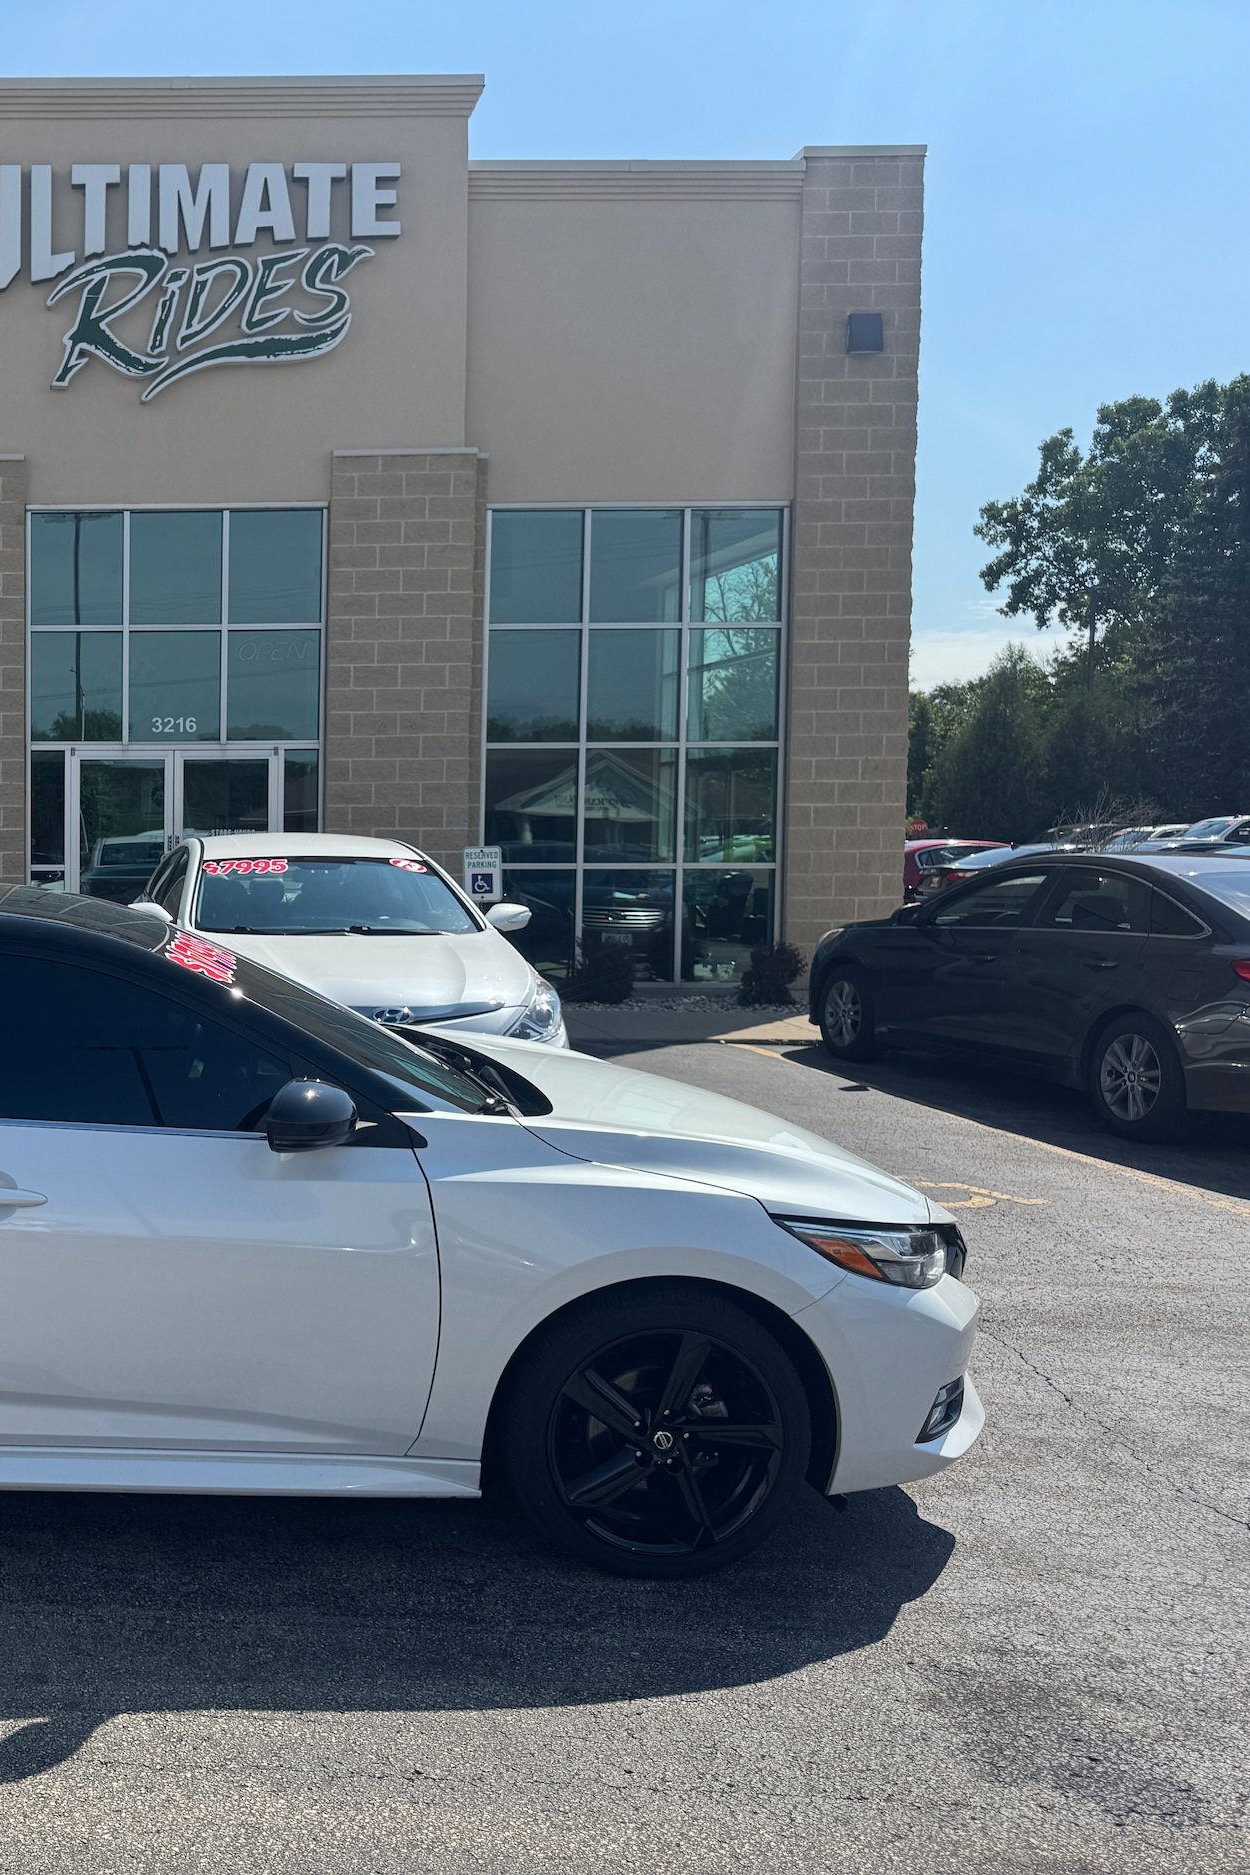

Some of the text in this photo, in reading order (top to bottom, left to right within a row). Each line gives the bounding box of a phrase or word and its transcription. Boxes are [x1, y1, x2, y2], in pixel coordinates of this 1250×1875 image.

[239, 641, 308, 661] OPEN
[151, 717, 197, 733] 3216
[465, 851, 499, 860] RESERVED
[202, 858, 289, 875] $7995
[467, 861, 498, 869] PARKING
